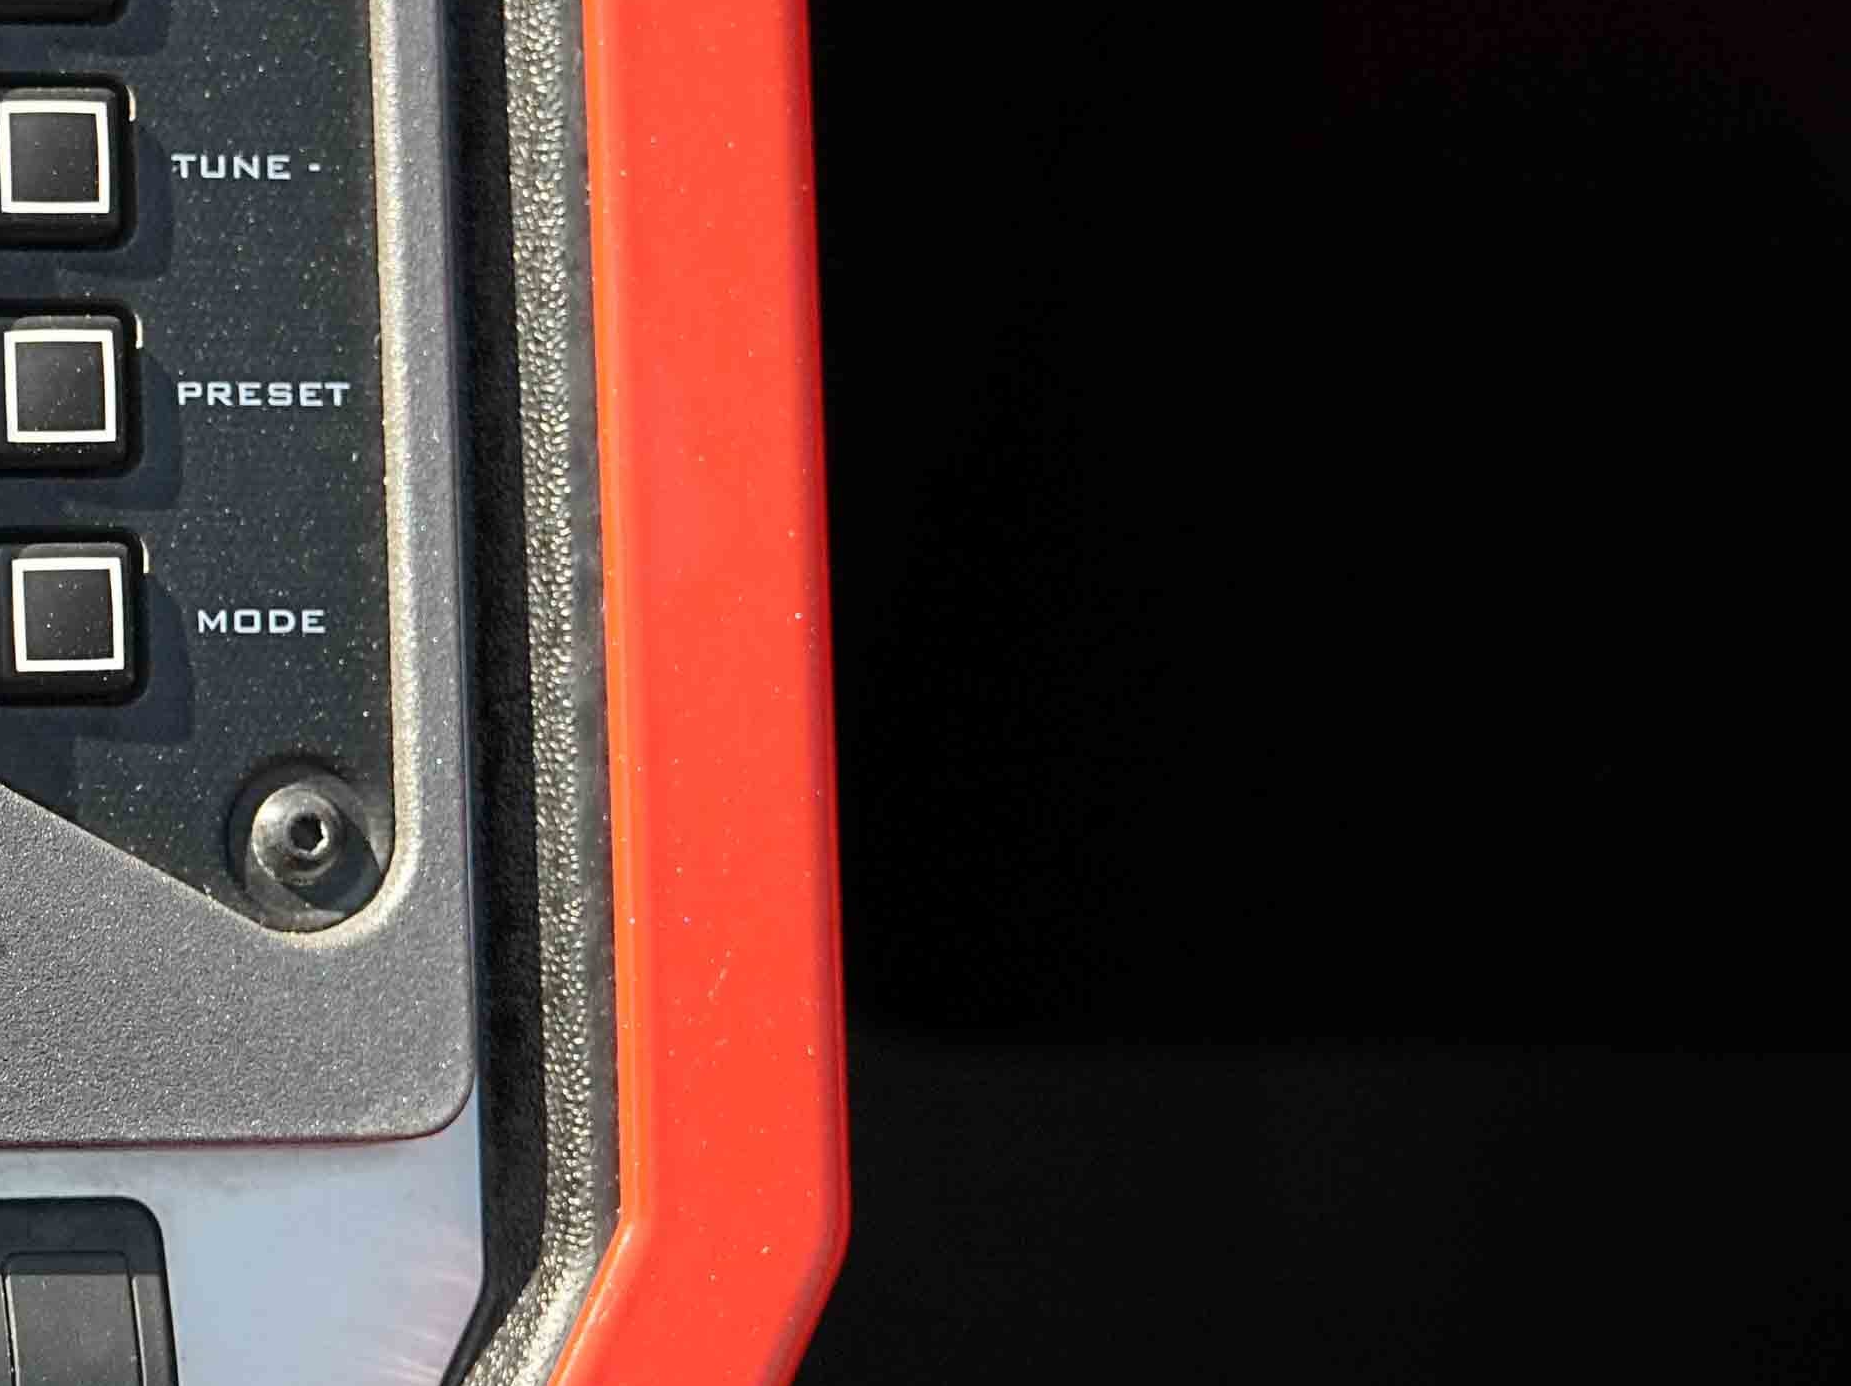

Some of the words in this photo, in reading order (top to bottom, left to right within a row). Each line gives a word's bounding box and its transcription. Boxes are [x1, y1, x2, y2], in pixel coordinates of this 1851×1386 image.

[171, 152, 293, 181] TUNE
[176, 380, 352, 408] PRESET
[196, 608, 327, 635] MODE
